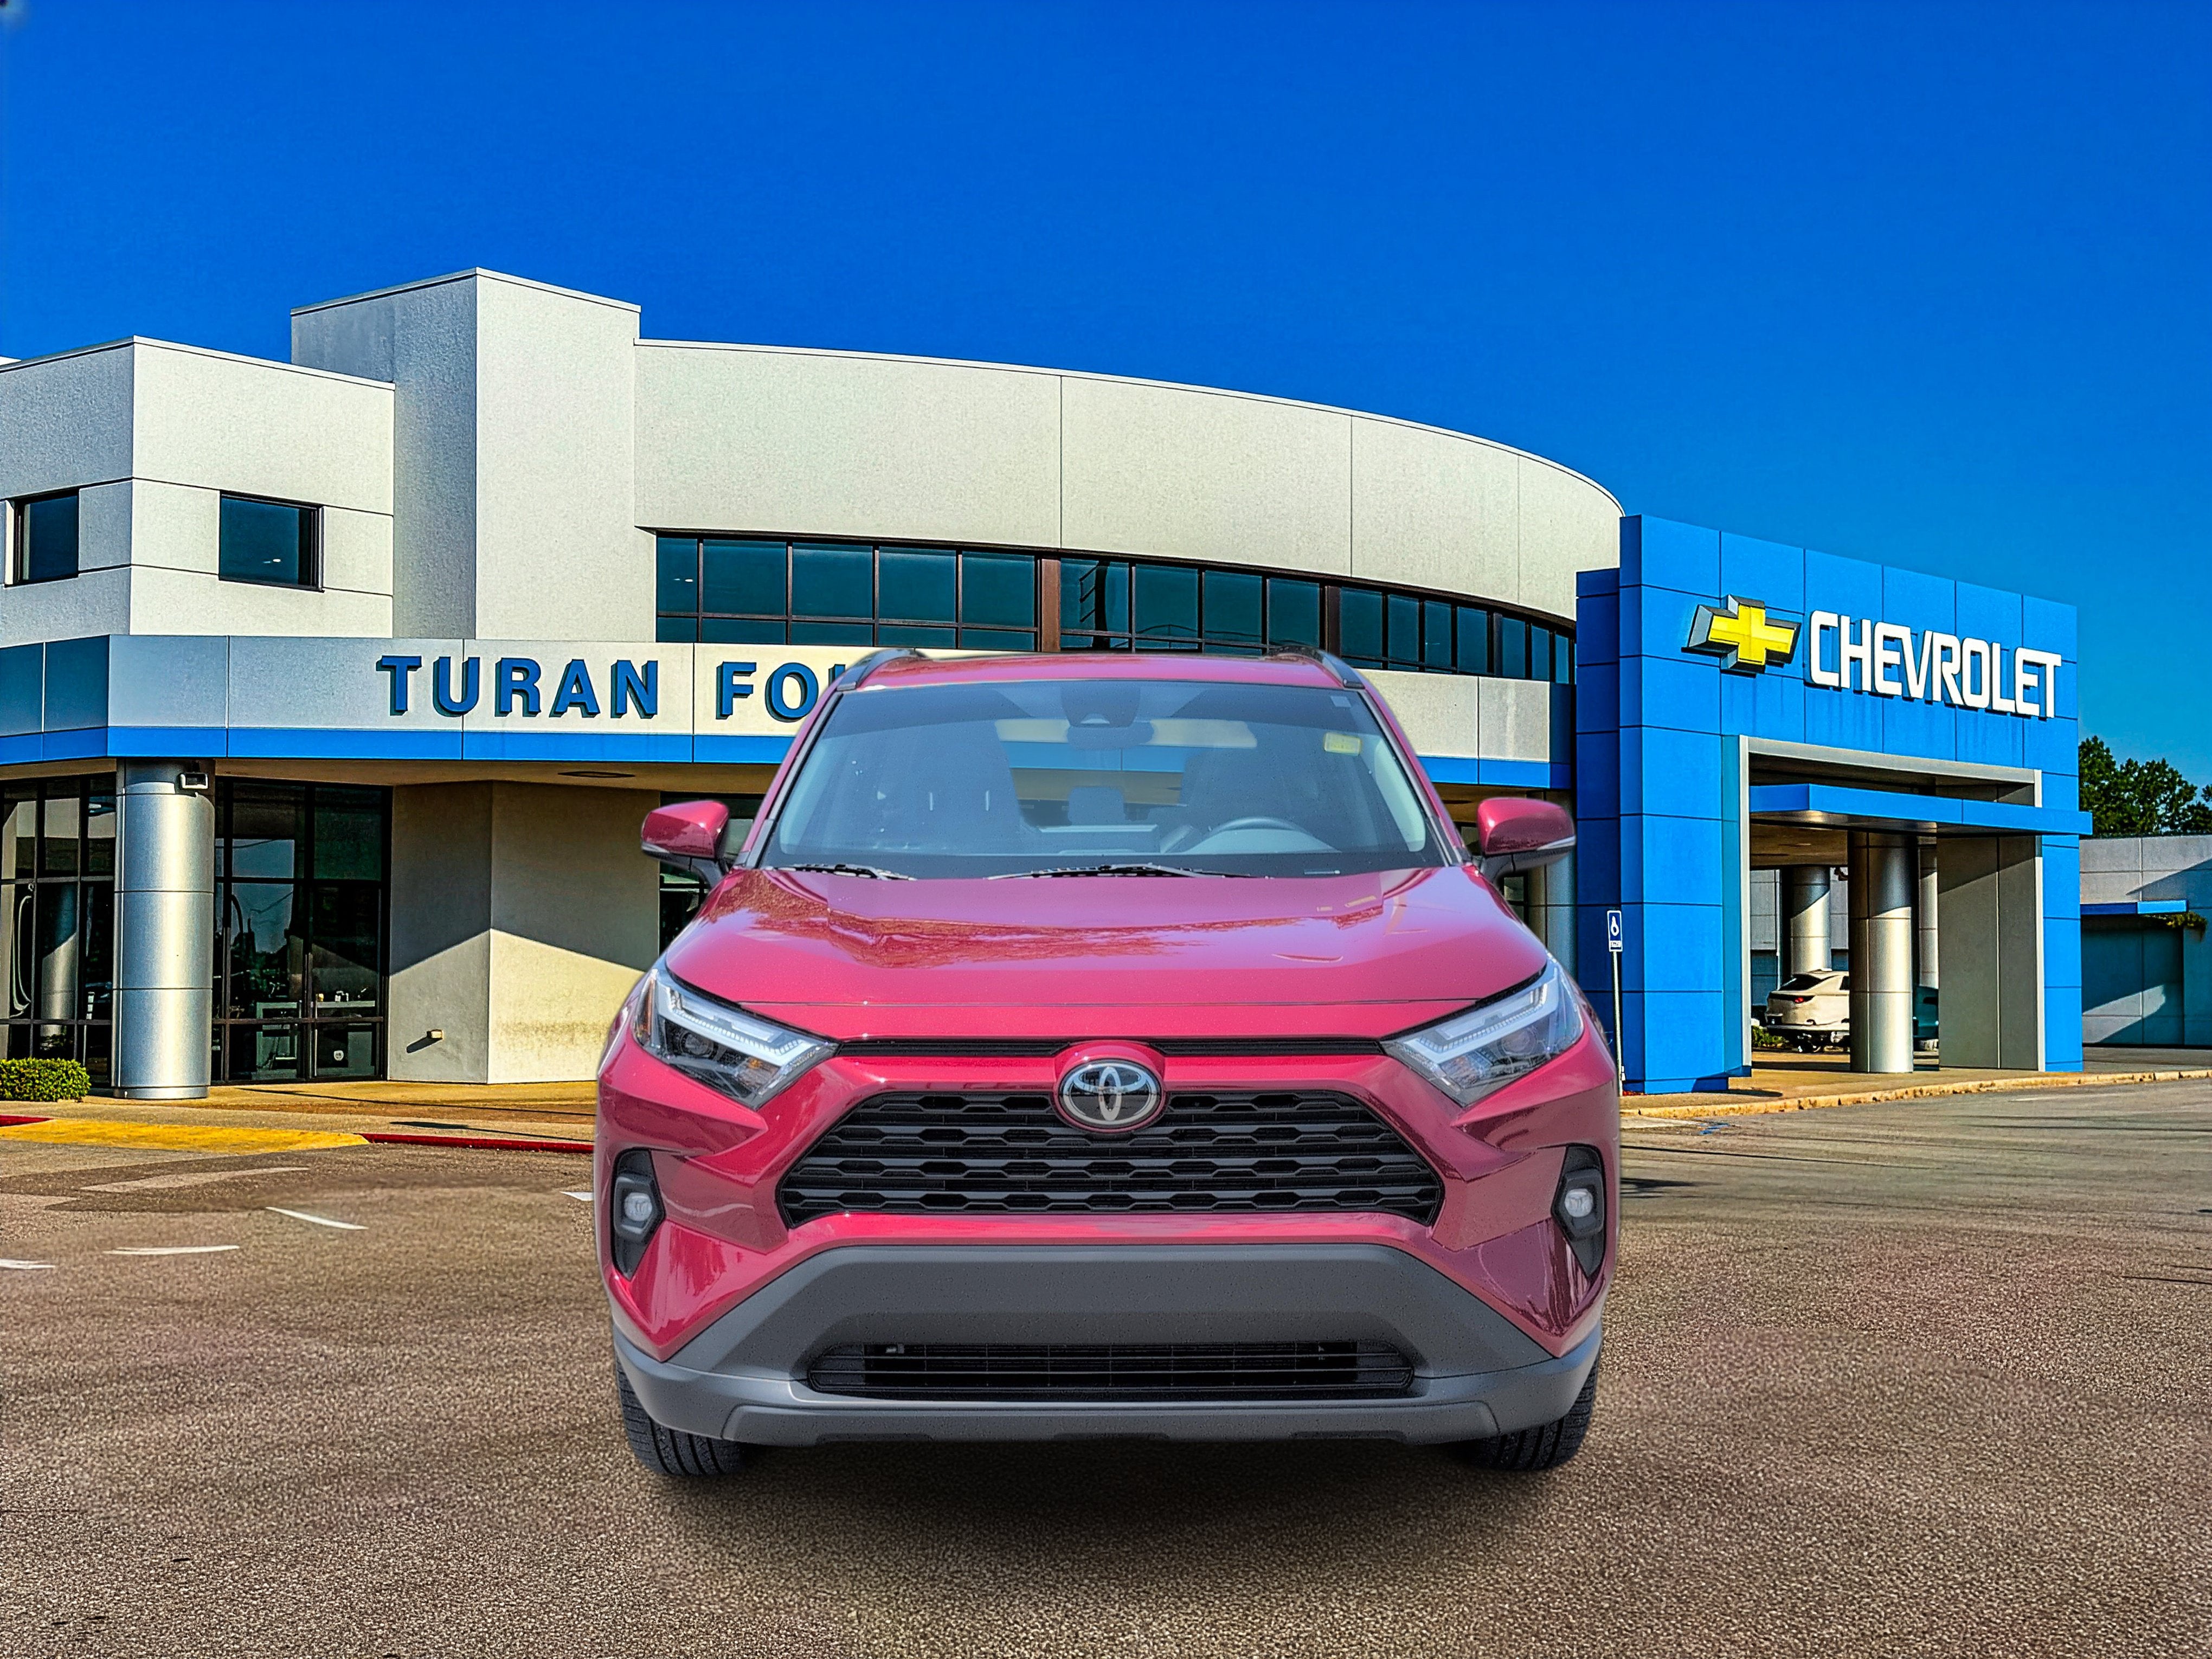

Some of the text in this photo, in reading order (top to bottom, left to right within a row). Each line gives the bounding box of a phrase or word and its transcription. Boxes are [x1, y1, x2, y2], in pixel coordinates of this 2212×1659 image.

[377, 655, 846, 723] TURAN FO
[1809, 610, 2062, 718] CHEVROLET
